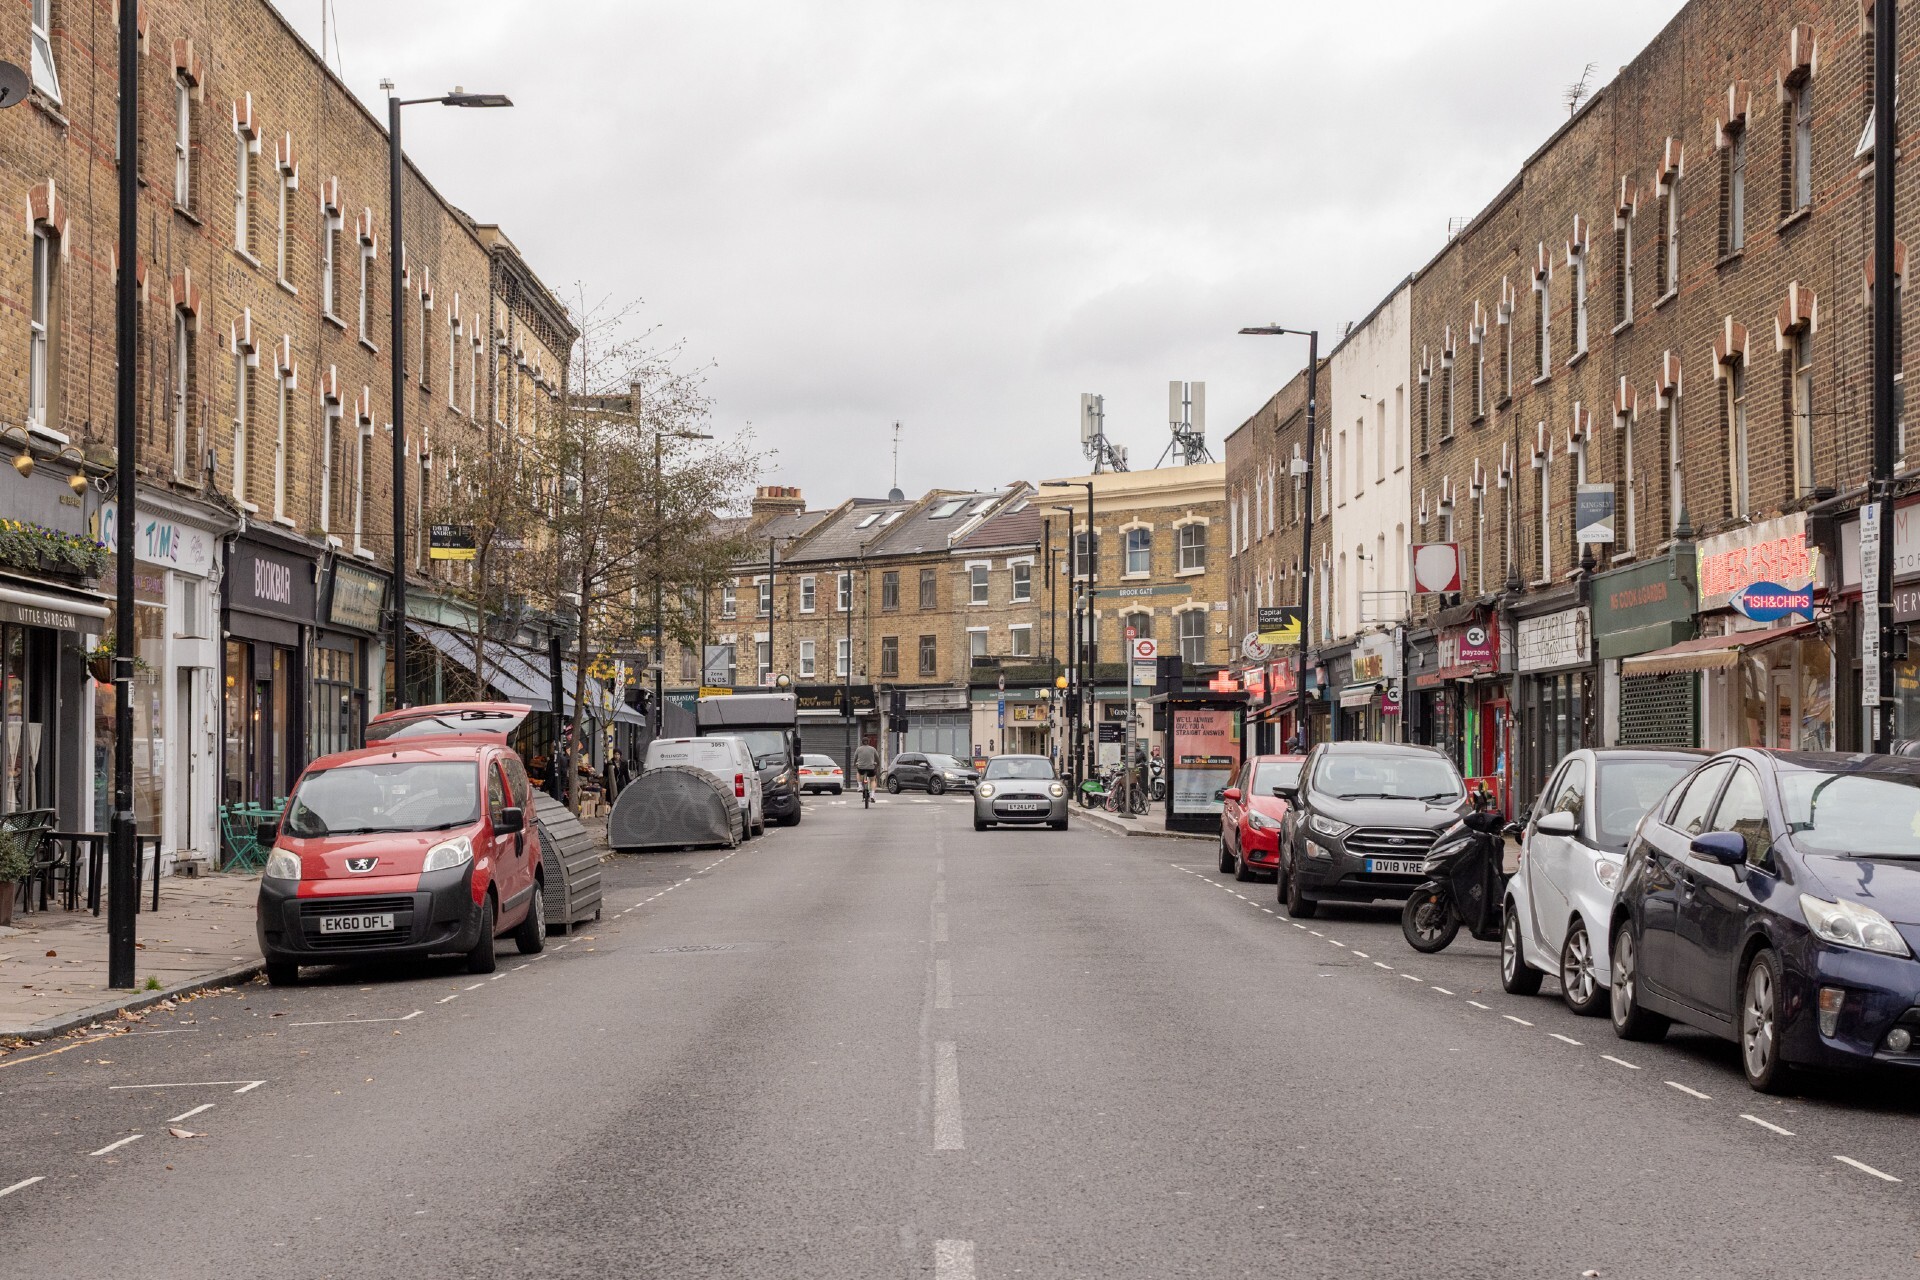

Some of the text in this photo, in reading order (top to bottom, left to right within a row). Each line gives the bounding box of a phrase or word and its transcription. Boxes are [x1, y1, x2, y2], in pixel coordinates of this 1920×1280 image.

[146, 521, 181, 562] TIME
[255, 557, 291, 604] BOOKBAR
[18, 607, 41, 623] LITTLE
[1462, 649, 1490, 657] payzone
[1375, 861, 1423, 873] OV18 VRE
[325, 915, 389, 931] EK60 OFL
